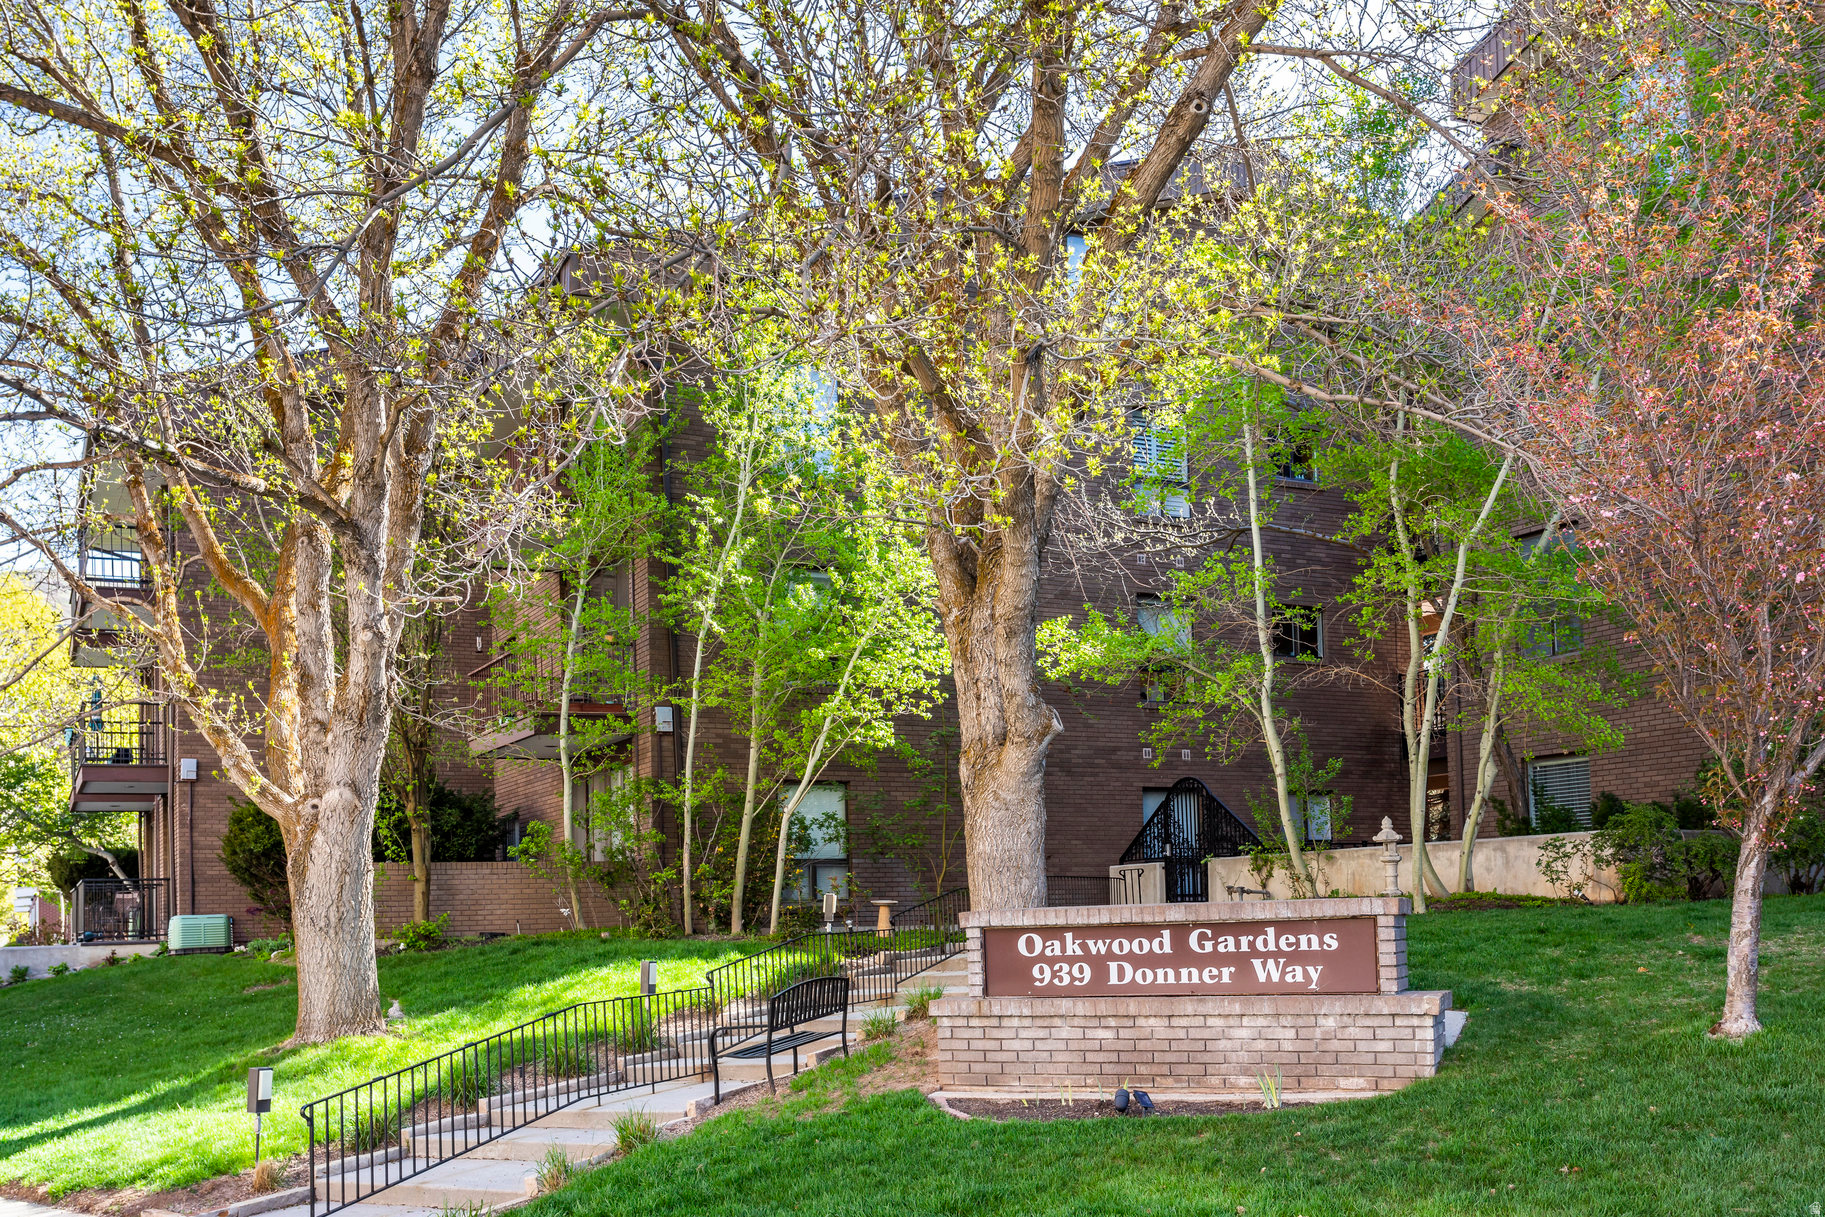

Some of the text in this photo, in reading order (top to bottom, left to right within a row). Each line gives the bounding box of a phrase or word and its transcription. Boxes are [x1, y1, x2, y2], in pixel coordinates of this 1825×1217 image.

[1017, 927, 1339, 958] Oakwood Gardens
[1031, 958, 1324, 991] 939 Donner Way
